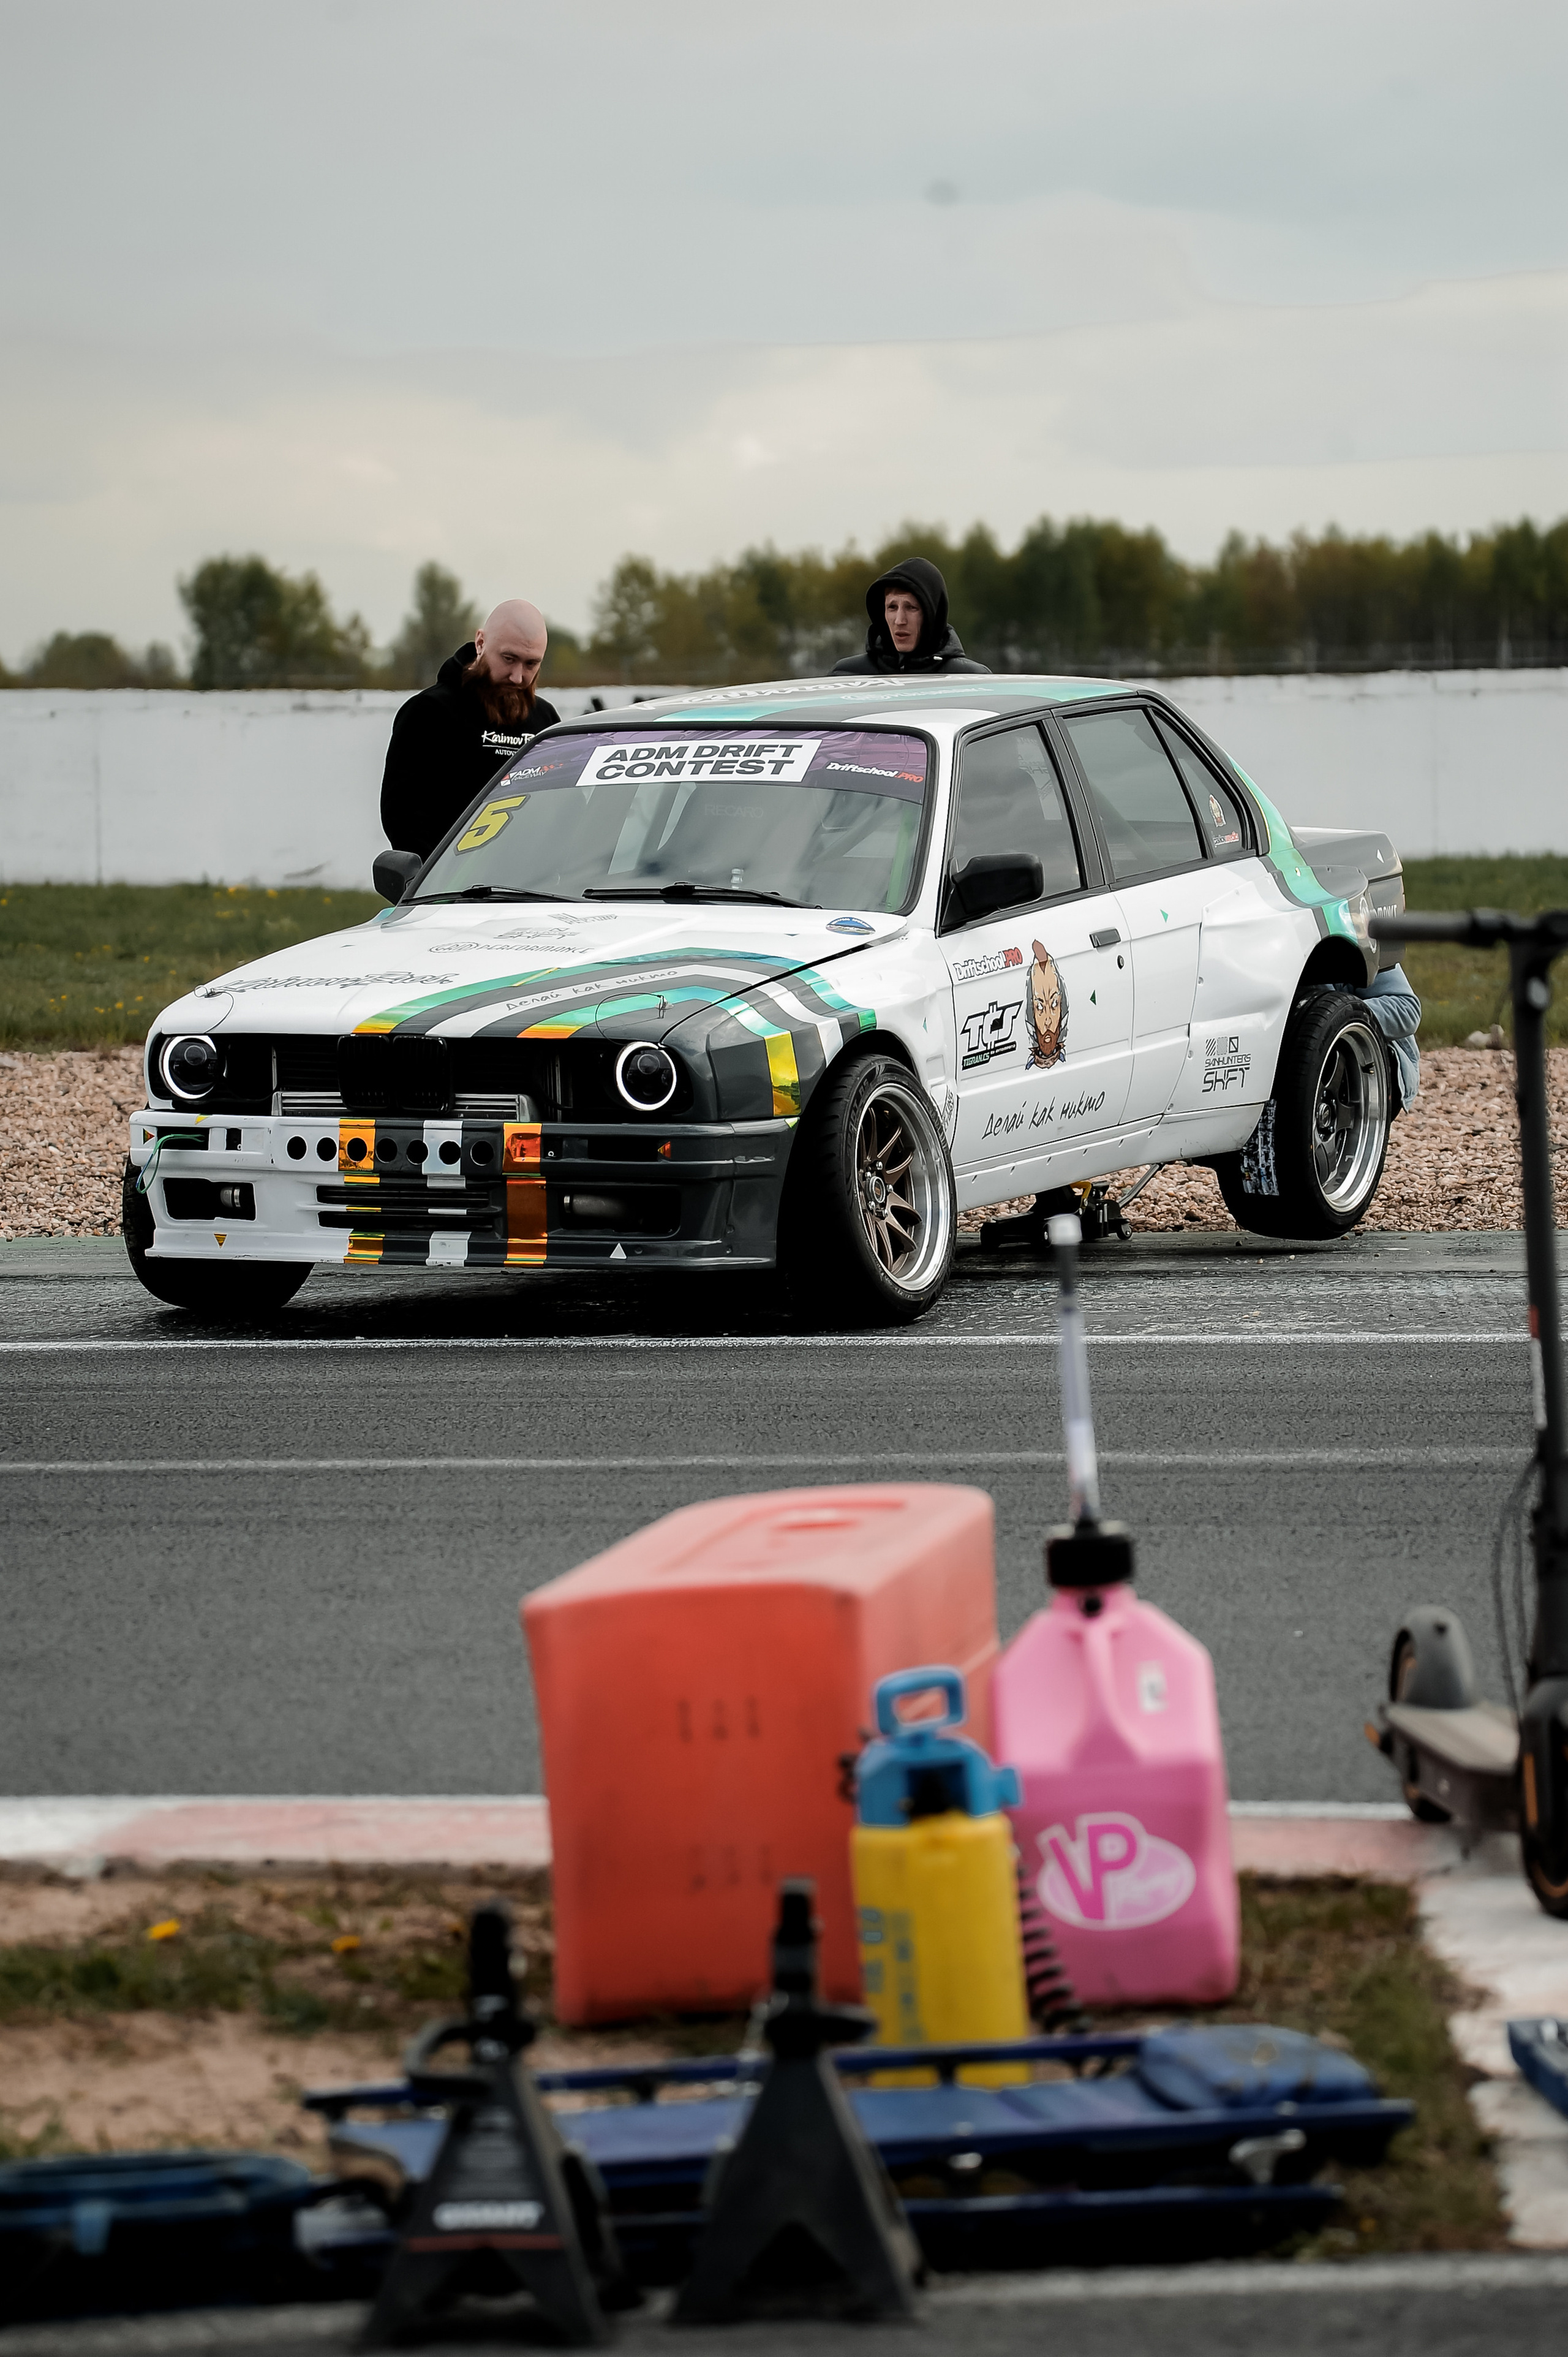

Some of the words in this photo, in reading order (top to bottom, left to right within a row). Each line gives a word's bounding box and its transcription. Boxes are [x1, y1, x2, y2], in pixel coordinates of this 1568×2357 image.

[481, 730, 523, 745] Karimov
[603, 746, 690, 763] ADM
[693, 744, 803, 758] DRIFT
[514, 766, 541, 777] ADM
[596, 759, 794, 780] CONTEST
[826, 762, 924, 784] Driftschool.PRO
[704, 804, 764, 819] RECARO
[455, 795, 529, 855] 5
[476, 944, 595, 954] PERFORMANCE
[953, 947, 1023, 981] Driftschool.PRO
[505, 991, 562, 1011] Делай
[572, 982, 611, 994] как
[982, 1100, 1027, 1140] Делай
[1028, 1096, 1055, 1130] как
[1060, 1091, 1106, 1121] никто
[1047, 1822, 1138, 1921] VP
